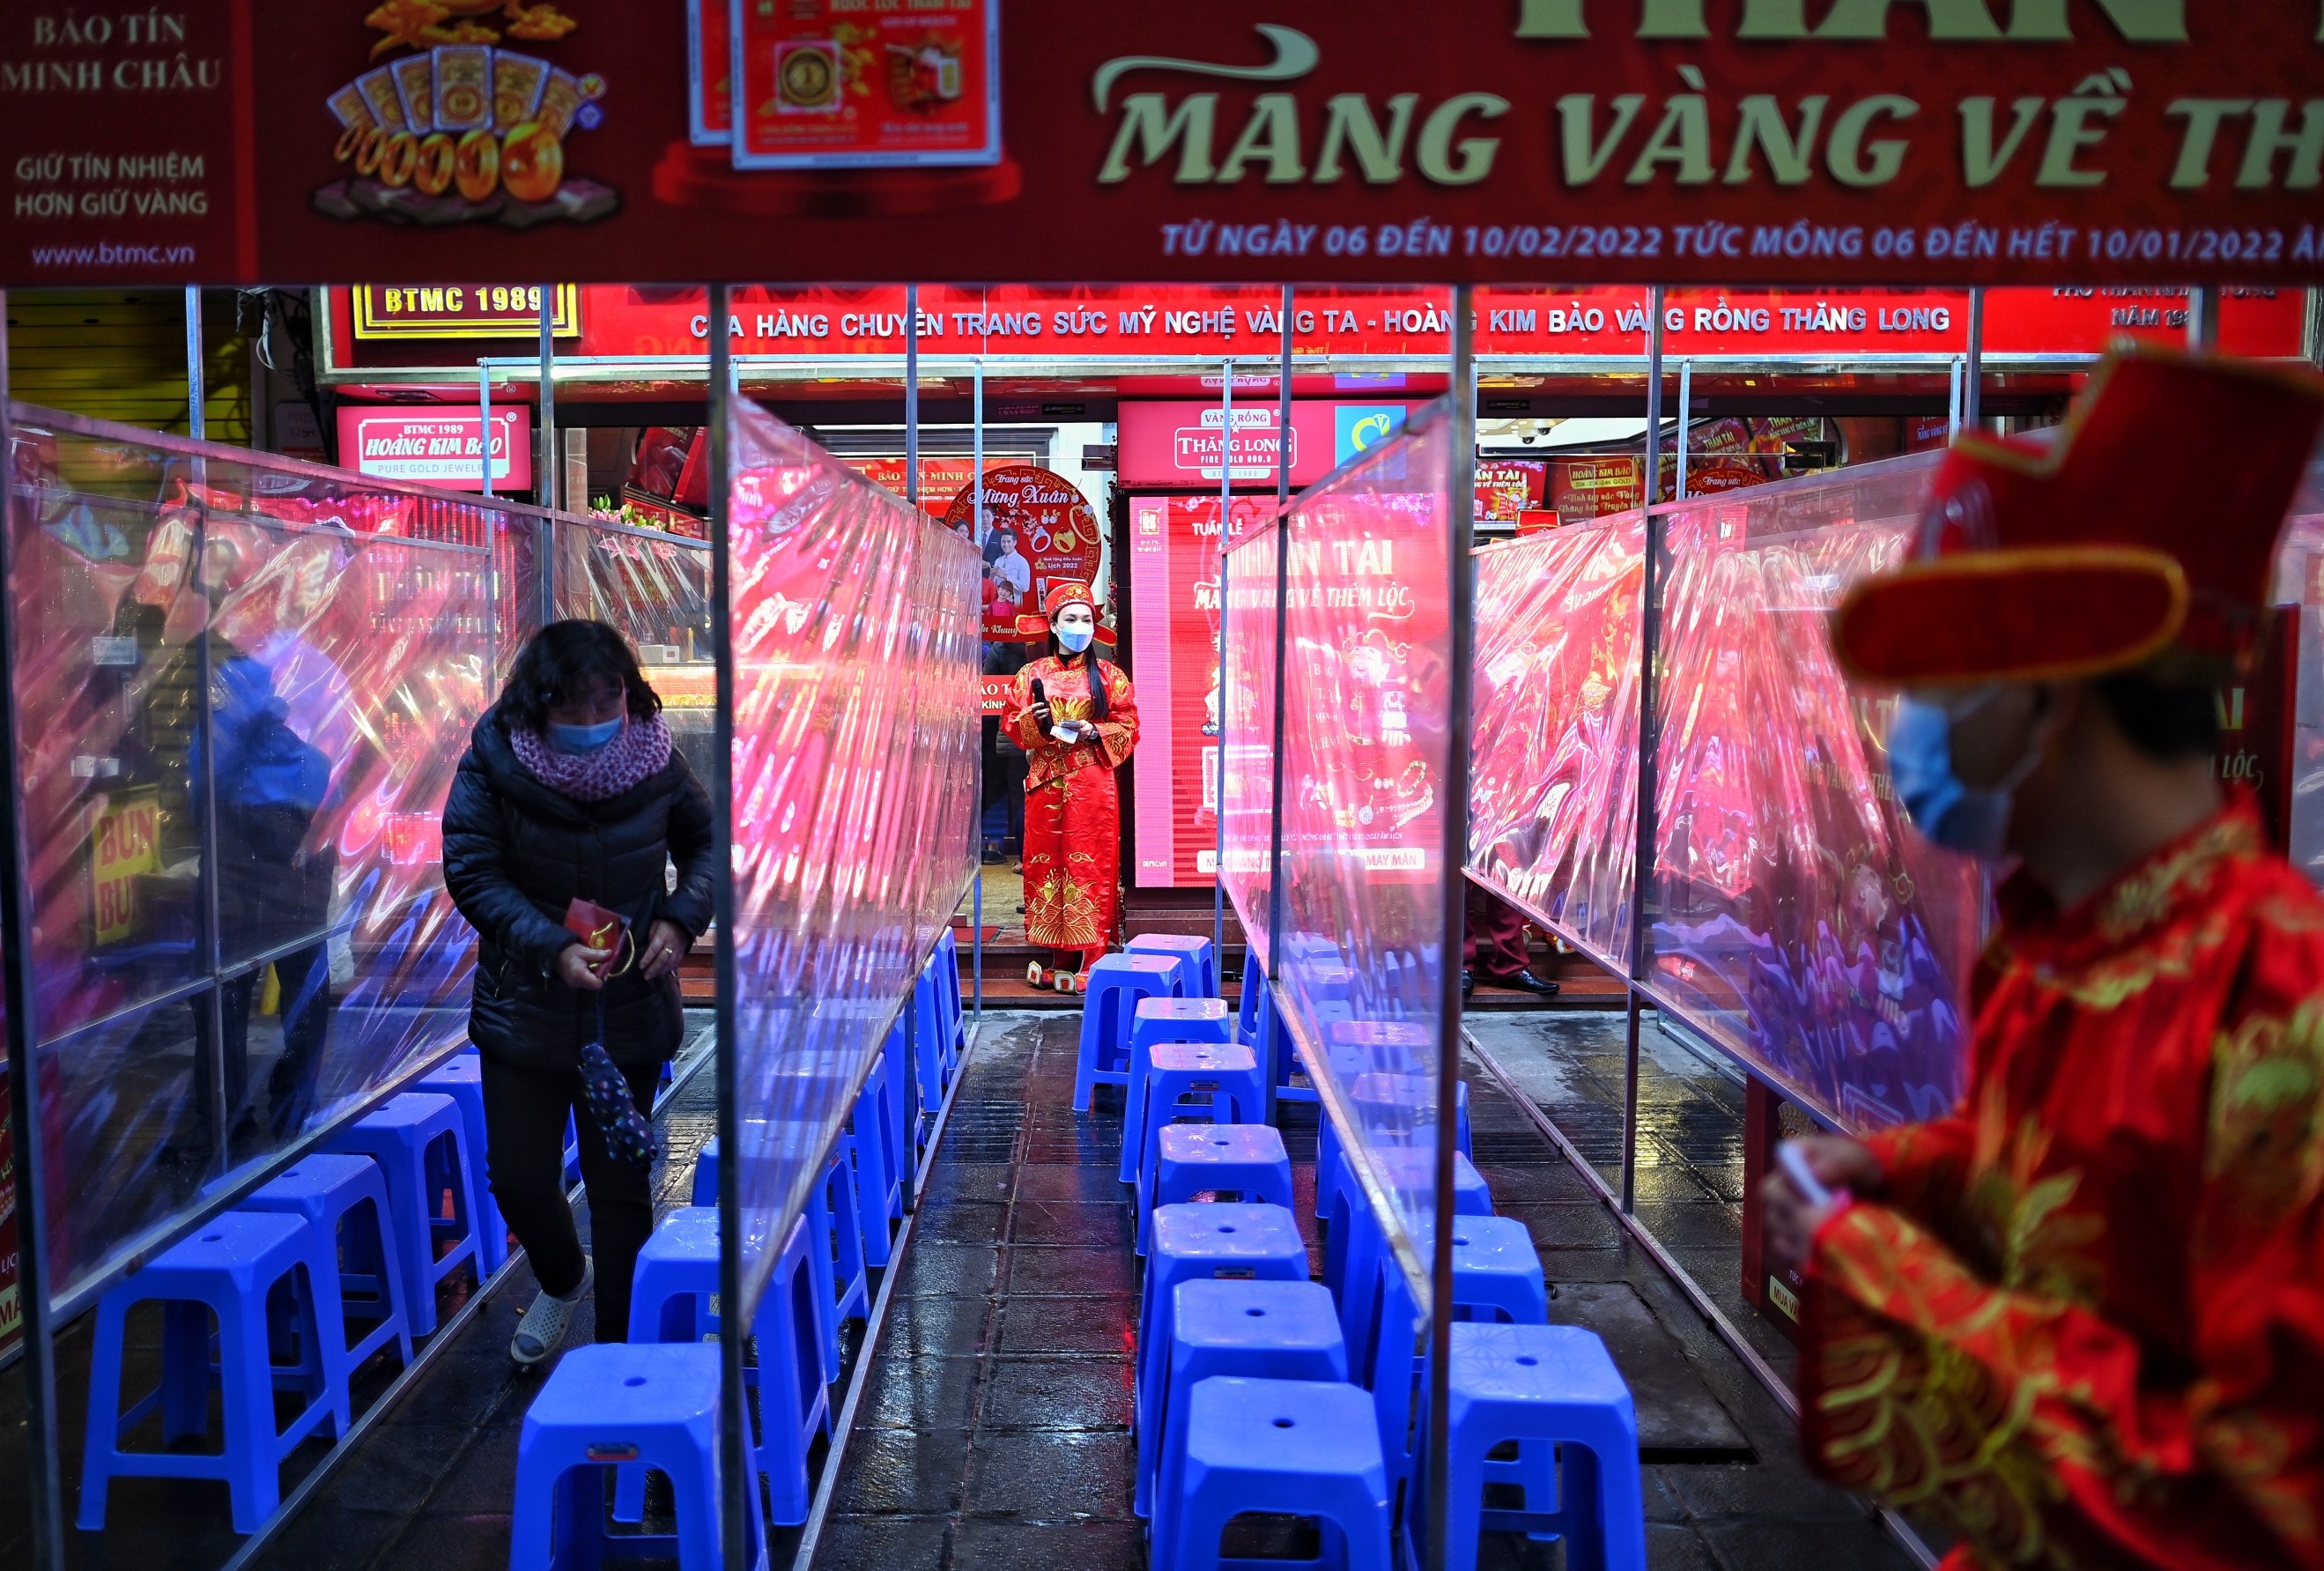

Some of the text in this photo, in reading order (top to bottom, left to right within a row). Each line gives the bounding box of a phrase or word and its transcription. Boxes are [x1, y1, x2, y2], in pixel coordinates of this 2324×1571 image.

[33, 6, 186, 46] BẢO TÍN
[1, 53, 221, 91] MINH CHÂU
[1098, 92, 1511, 185] MANG
[1557, 64, 1921, 186] VÀNG
[1957, 68, 2134, 188] VỀ
[16, 149, 204, 185] GIỮ TÍN NHIỆM
[15, 189, 208, 217] HƠN GIỮ VÀNG
[1161, 219, 1213, 256] TỪ
[1218, 219, 1316, 256] NGÀY
[1323, 226, 1367, 255] 06
[1377, 215, 1452, 256] ĐẾN
[1464, 226, 1662, 258] 10/02/2022
[1674, 219, 1743, 256] TỨC
[1872, 227, 1915, 257] 06
[1925, 219, 2000, 258] ĐẾN
[2008, 219, 2076, 258] HẾT
[2089, 230, 2283, 260] 10/01/2022
[33, 242, 195, 263] www.btmc.vn
[384, 286, 542, 311] BTMC 1989
[690, 308, 744, 338] CA
[757, 308, 829, 338] HÀNG
[840, 307, 944, 337] CHUYÊN
[951, 311, 1041, 337] TRANG
[1053, 303, 1107, 335] SỨC
[1118, 304, 1158, 334] MỸ
[1165, 305, 1235, 340] NGHỆ
[1323, 310, 1358, 332] TA
[1489, 309, 1536, 333] KIM
[1548, 300, 1605, 333] BẢO
[1694, 296, 1770, 332] RỒNG
[1779, 303, 1867, 332] THĂNG
[1879, 307, 1950, 332] LONG
[2111, 306, 2160, 326] NĂM
[403, 425, 463, 434] BTMC 1989
[365, 434, 427, 456] HOÀNG
[427, 437, 463, 456] KIM
[409, 464, 440, 473] GOLD
[443, 464, 484, 473] JEWELR
[1228, 455, 1243, 463] OLD
[930, 471, 964, 480] MINH
[995, 474, 1019, 485] Trang
[1496, 468, 1520, 480] TÀI
[1703, 476, 1727, 486] Trang
[1022, 485, 1069, 504] Xuân
[1333, 531, 1394, 575] TÀI
[1774, 1286, 1788, 1310] MUA
